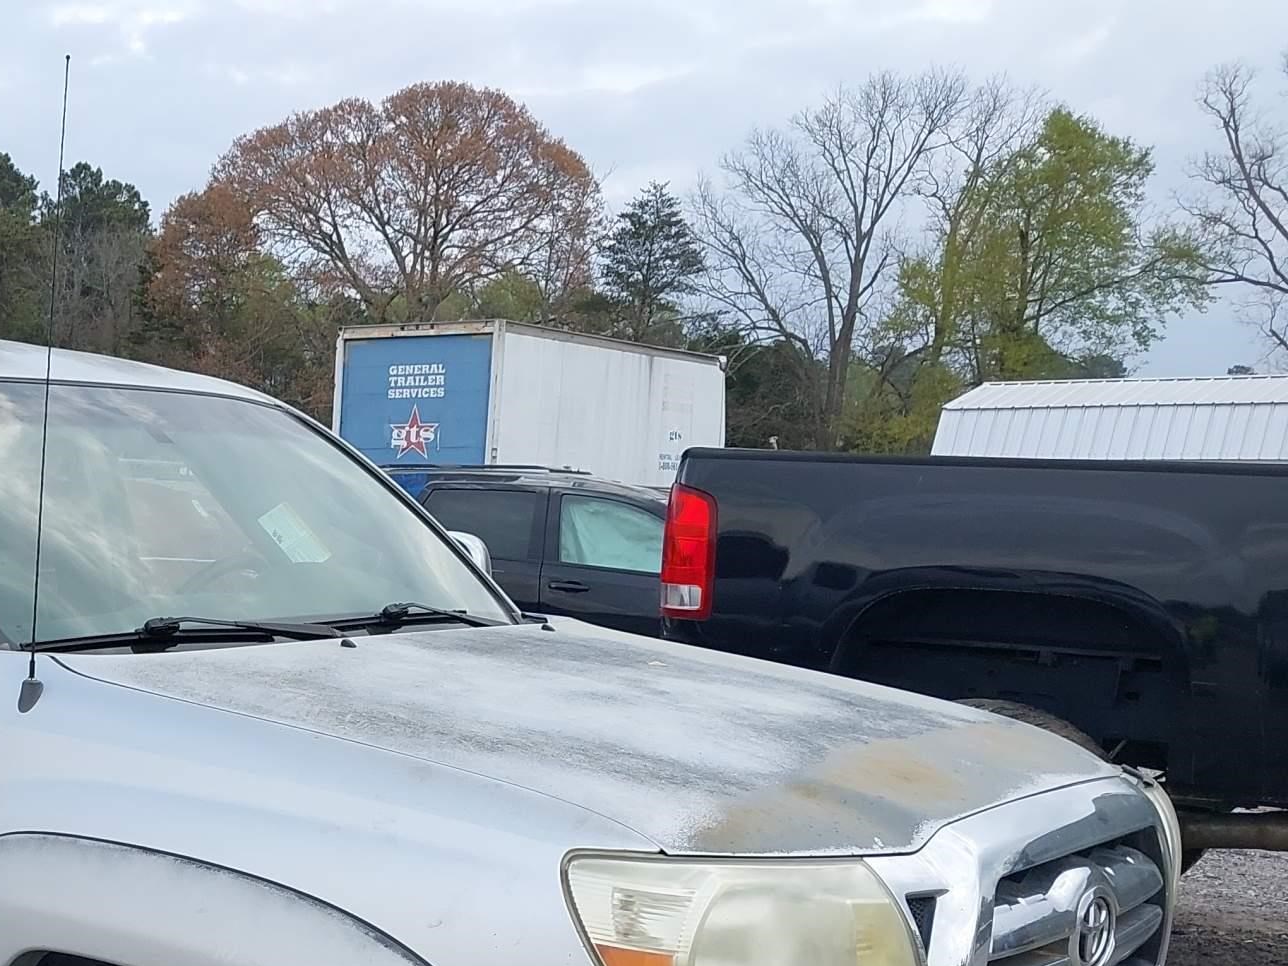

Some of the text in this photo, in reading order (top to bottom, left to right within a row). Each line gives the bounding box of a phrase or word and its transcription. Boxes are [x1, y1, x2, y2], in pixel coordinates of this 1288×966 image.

[388, 363, 446, 375] GENERAL
[388, 375, 445, 387] TRAILER
[387, 387, 445, 399] SERVICES
[391, 423, 435, 449] gts
